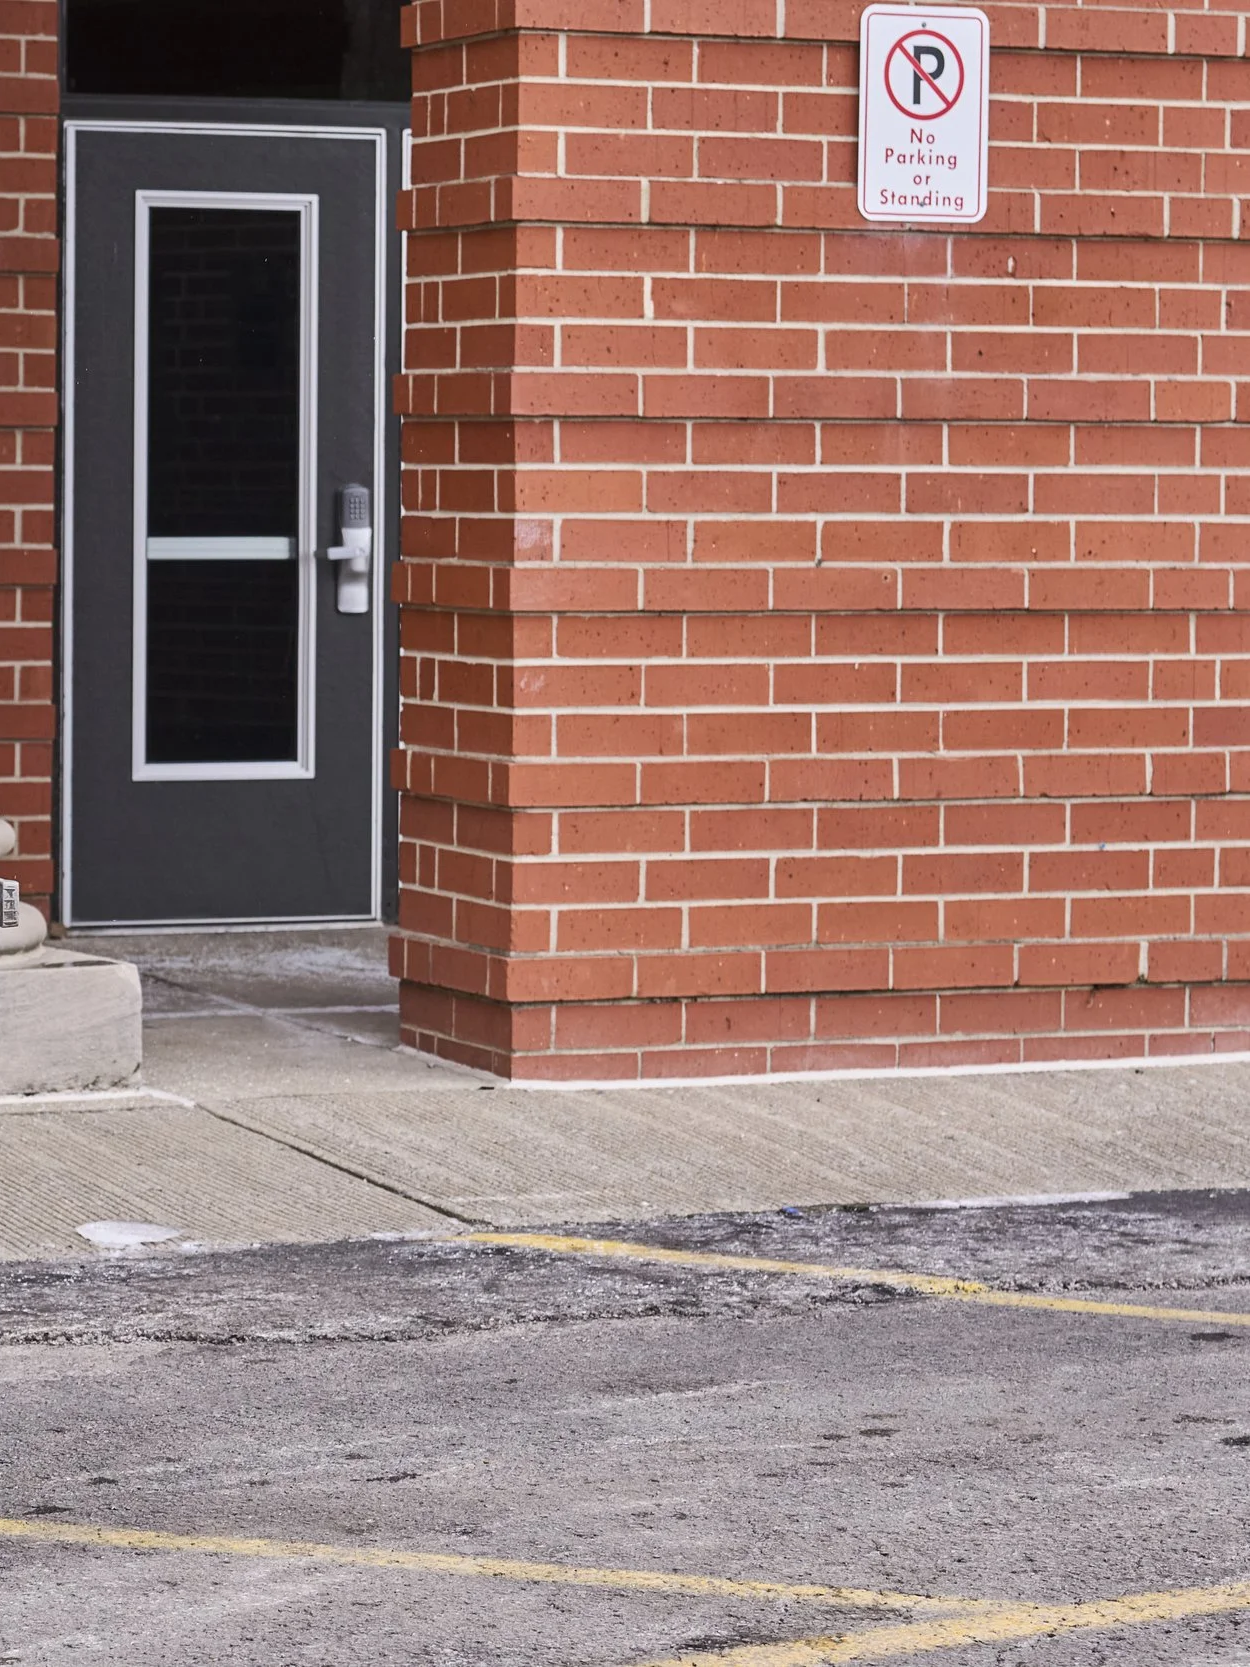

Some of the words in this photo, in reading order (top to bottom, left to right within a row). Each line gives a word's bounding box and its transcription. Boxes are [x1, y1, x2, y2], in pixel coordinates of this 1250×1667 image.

[913, 45, 945, 104] P
[910, 128, 935, 144] No
[885, 148, 957, 170] Parking
[913, 174, 931, 186] or
[880, 188, 964, 211] Standing
